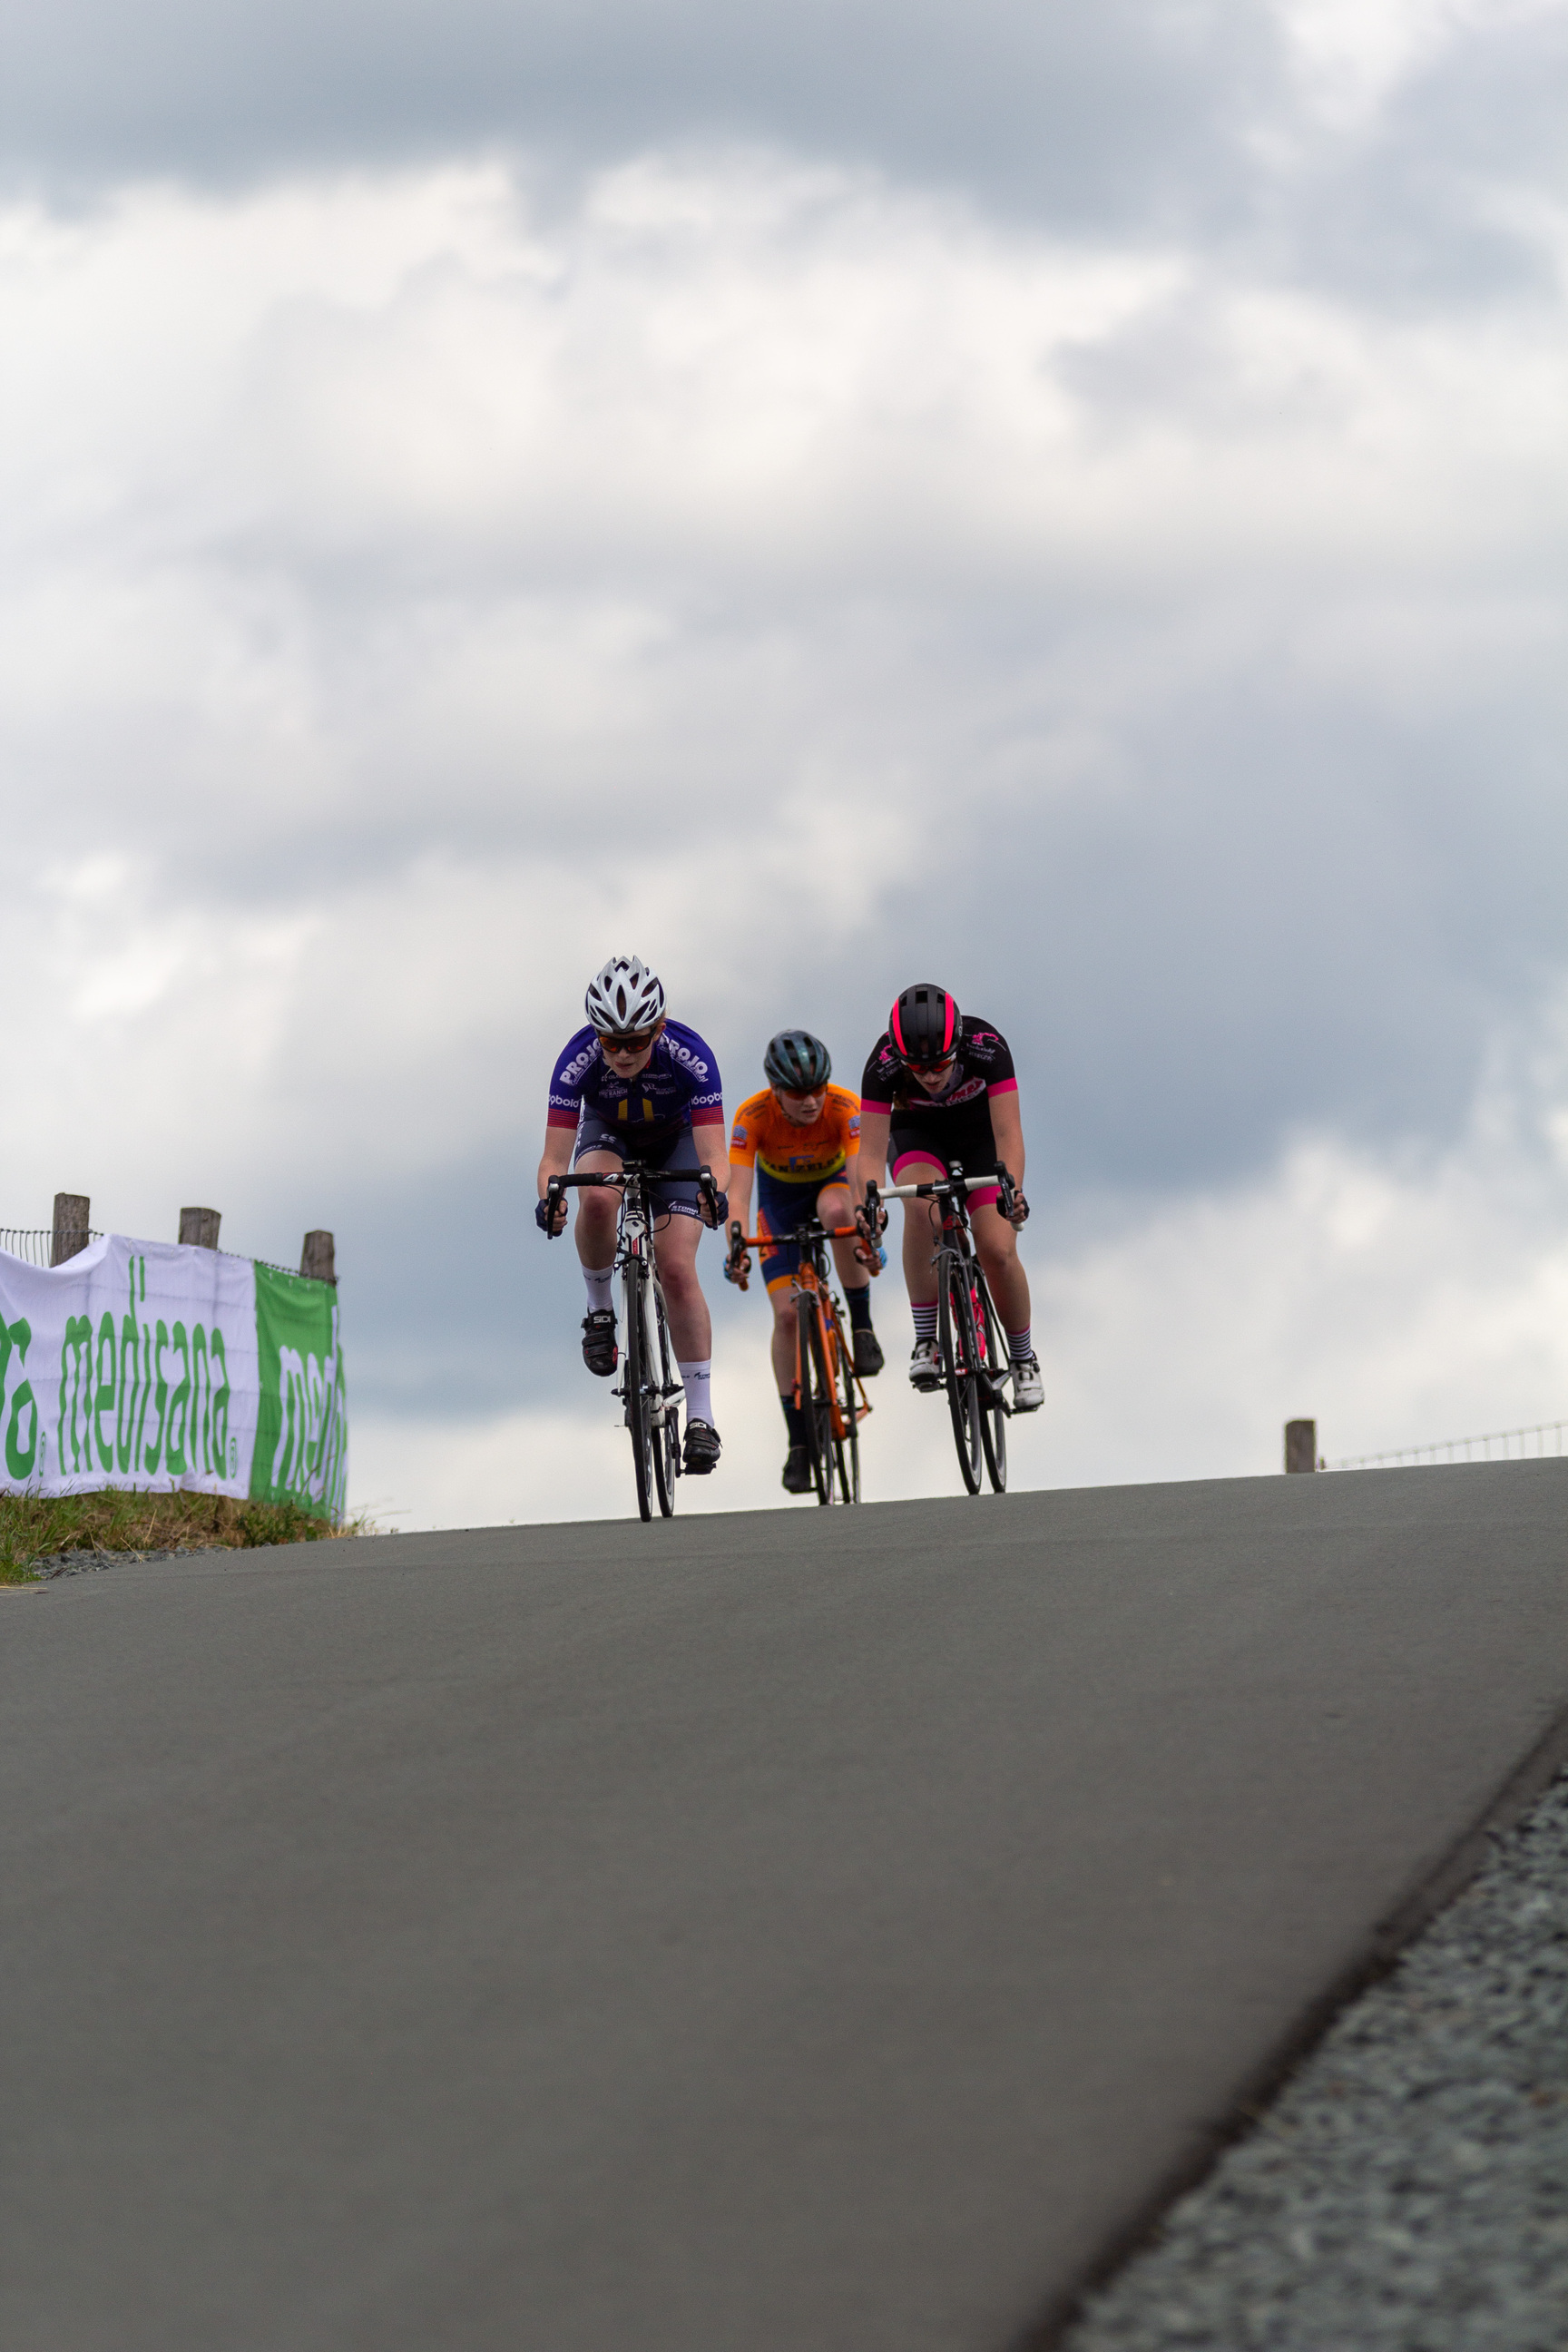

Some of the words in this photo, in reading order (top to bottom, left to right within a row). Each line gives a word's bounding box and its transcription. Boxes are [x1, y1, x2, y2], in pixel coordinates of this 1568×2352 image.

[593, 1316, 612, 1324] SIDI
[57, 1256, 230, 1481] medisana
[689, 1422, 707, 1430] SIDI
